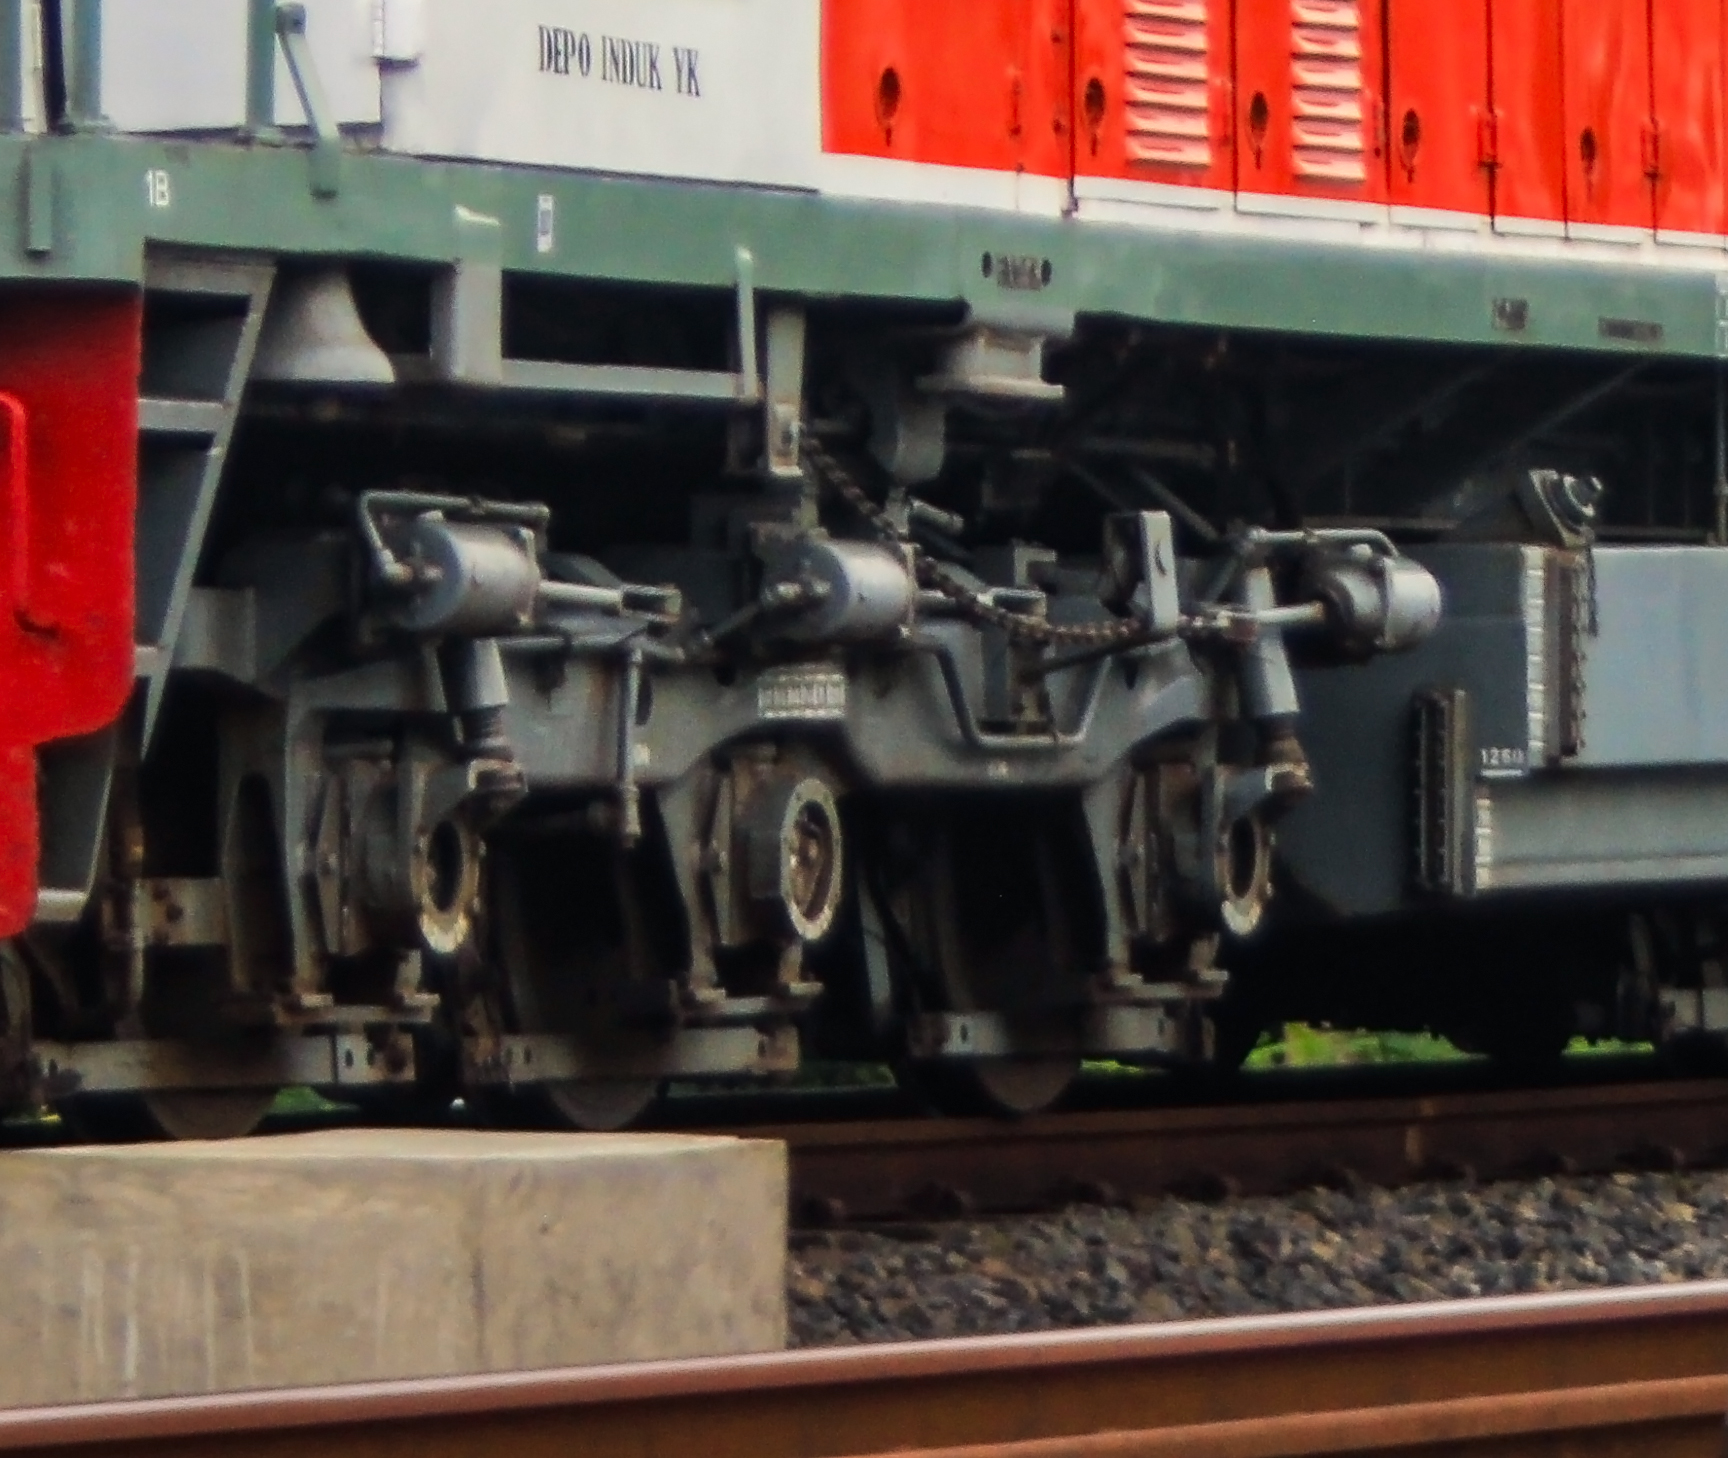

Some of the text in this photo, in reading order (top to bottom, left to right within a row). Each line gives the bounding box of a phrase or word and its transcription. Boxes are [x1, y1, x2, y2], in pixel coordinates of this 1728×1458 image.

[538, 24, 701, 98] DEPO INDUK YK
[147, 169, 170, 207] 1B
